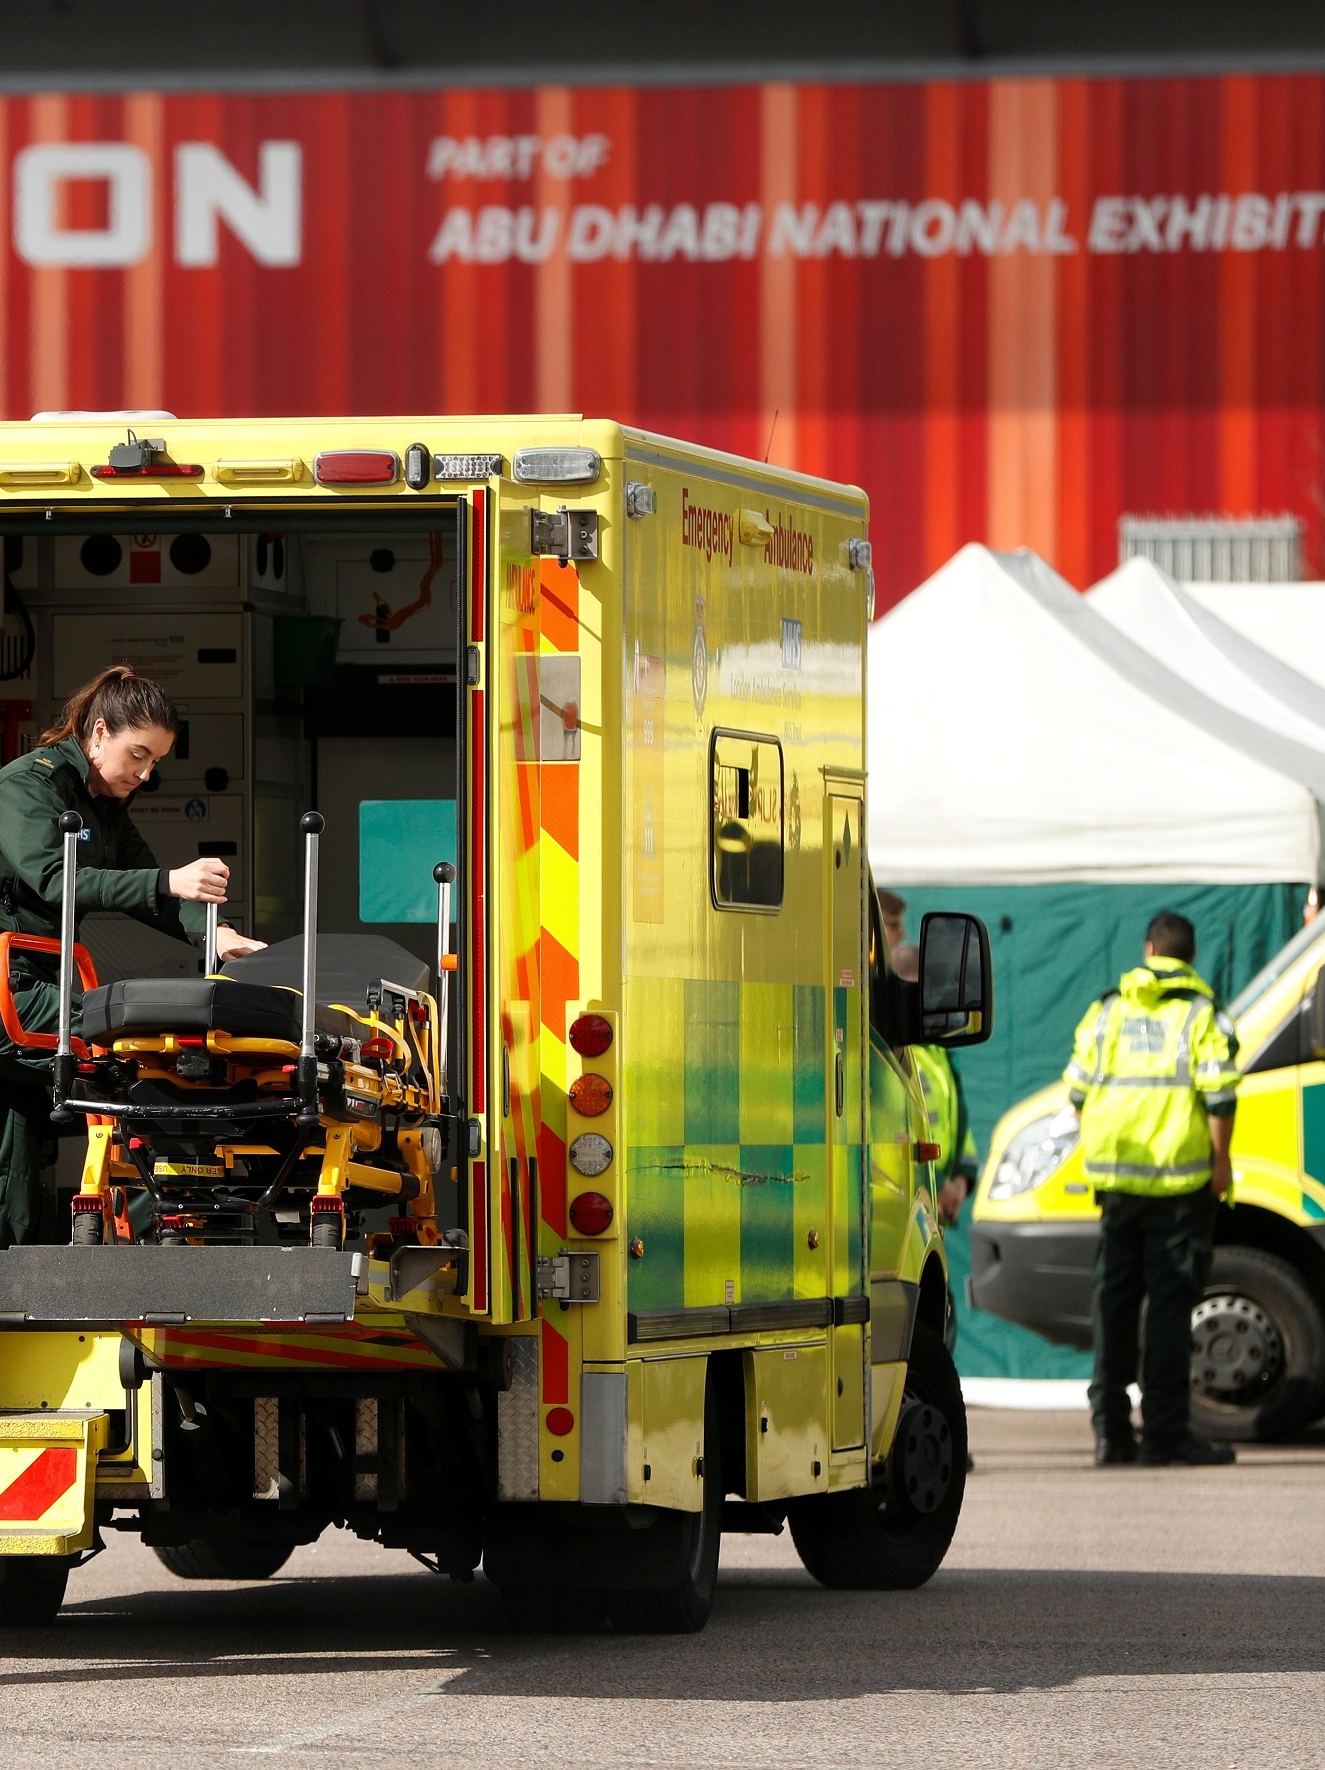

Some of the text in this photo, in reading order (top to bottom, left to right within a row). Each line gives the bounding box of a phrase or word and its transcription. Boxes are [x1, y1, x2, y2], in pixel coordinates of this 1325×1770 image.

[427, 134, 609, 178] PART OF
[430, 205, 562, 263] ABU
[566, 202, 761, 261] DHABI
[769, 198, 1076, 257] NATIONAL
[682, 487, 814, 576] Emergency Ambulance
[77, 829, 89, 841] HS
[155, 1165, 168, 1173] USE
[181, 1165, 204, 1174] ONLY
